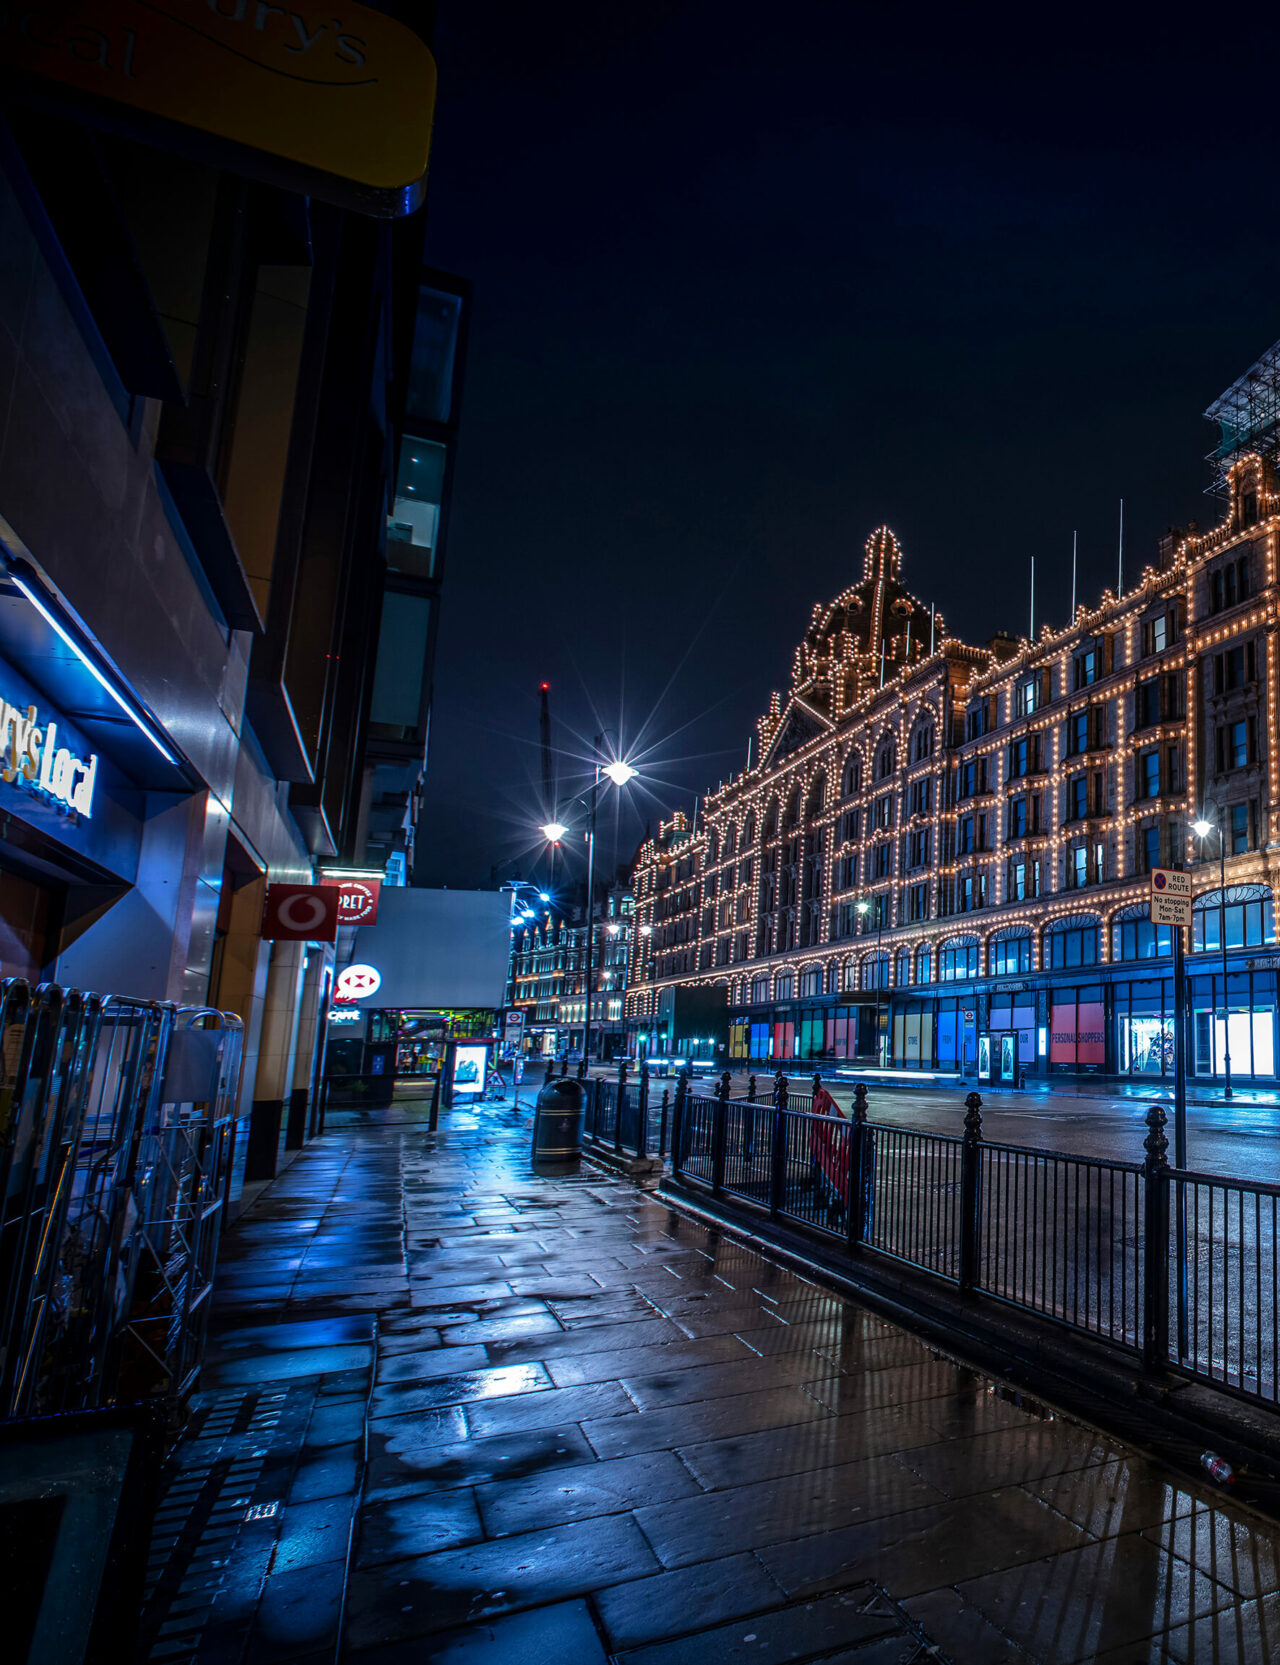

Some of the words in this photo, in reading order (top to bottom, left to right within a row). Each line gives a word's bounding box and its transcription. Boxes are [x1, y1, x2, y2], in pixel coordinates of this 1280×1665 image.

[0, 8, 136, 79] cal
[40, 722, 97, 819] Local
[1172, 875, 1185, 883] RED
[1168, 883, 1189, 892] ROUTE
[1164, 897, 1189, 907] stopping
[907, 1036, 918, 1045] STORE
[1052, 1033, 1076, 1044] PERSONAL
[1078, 1032, 1104, 1043] SHOPPERS
